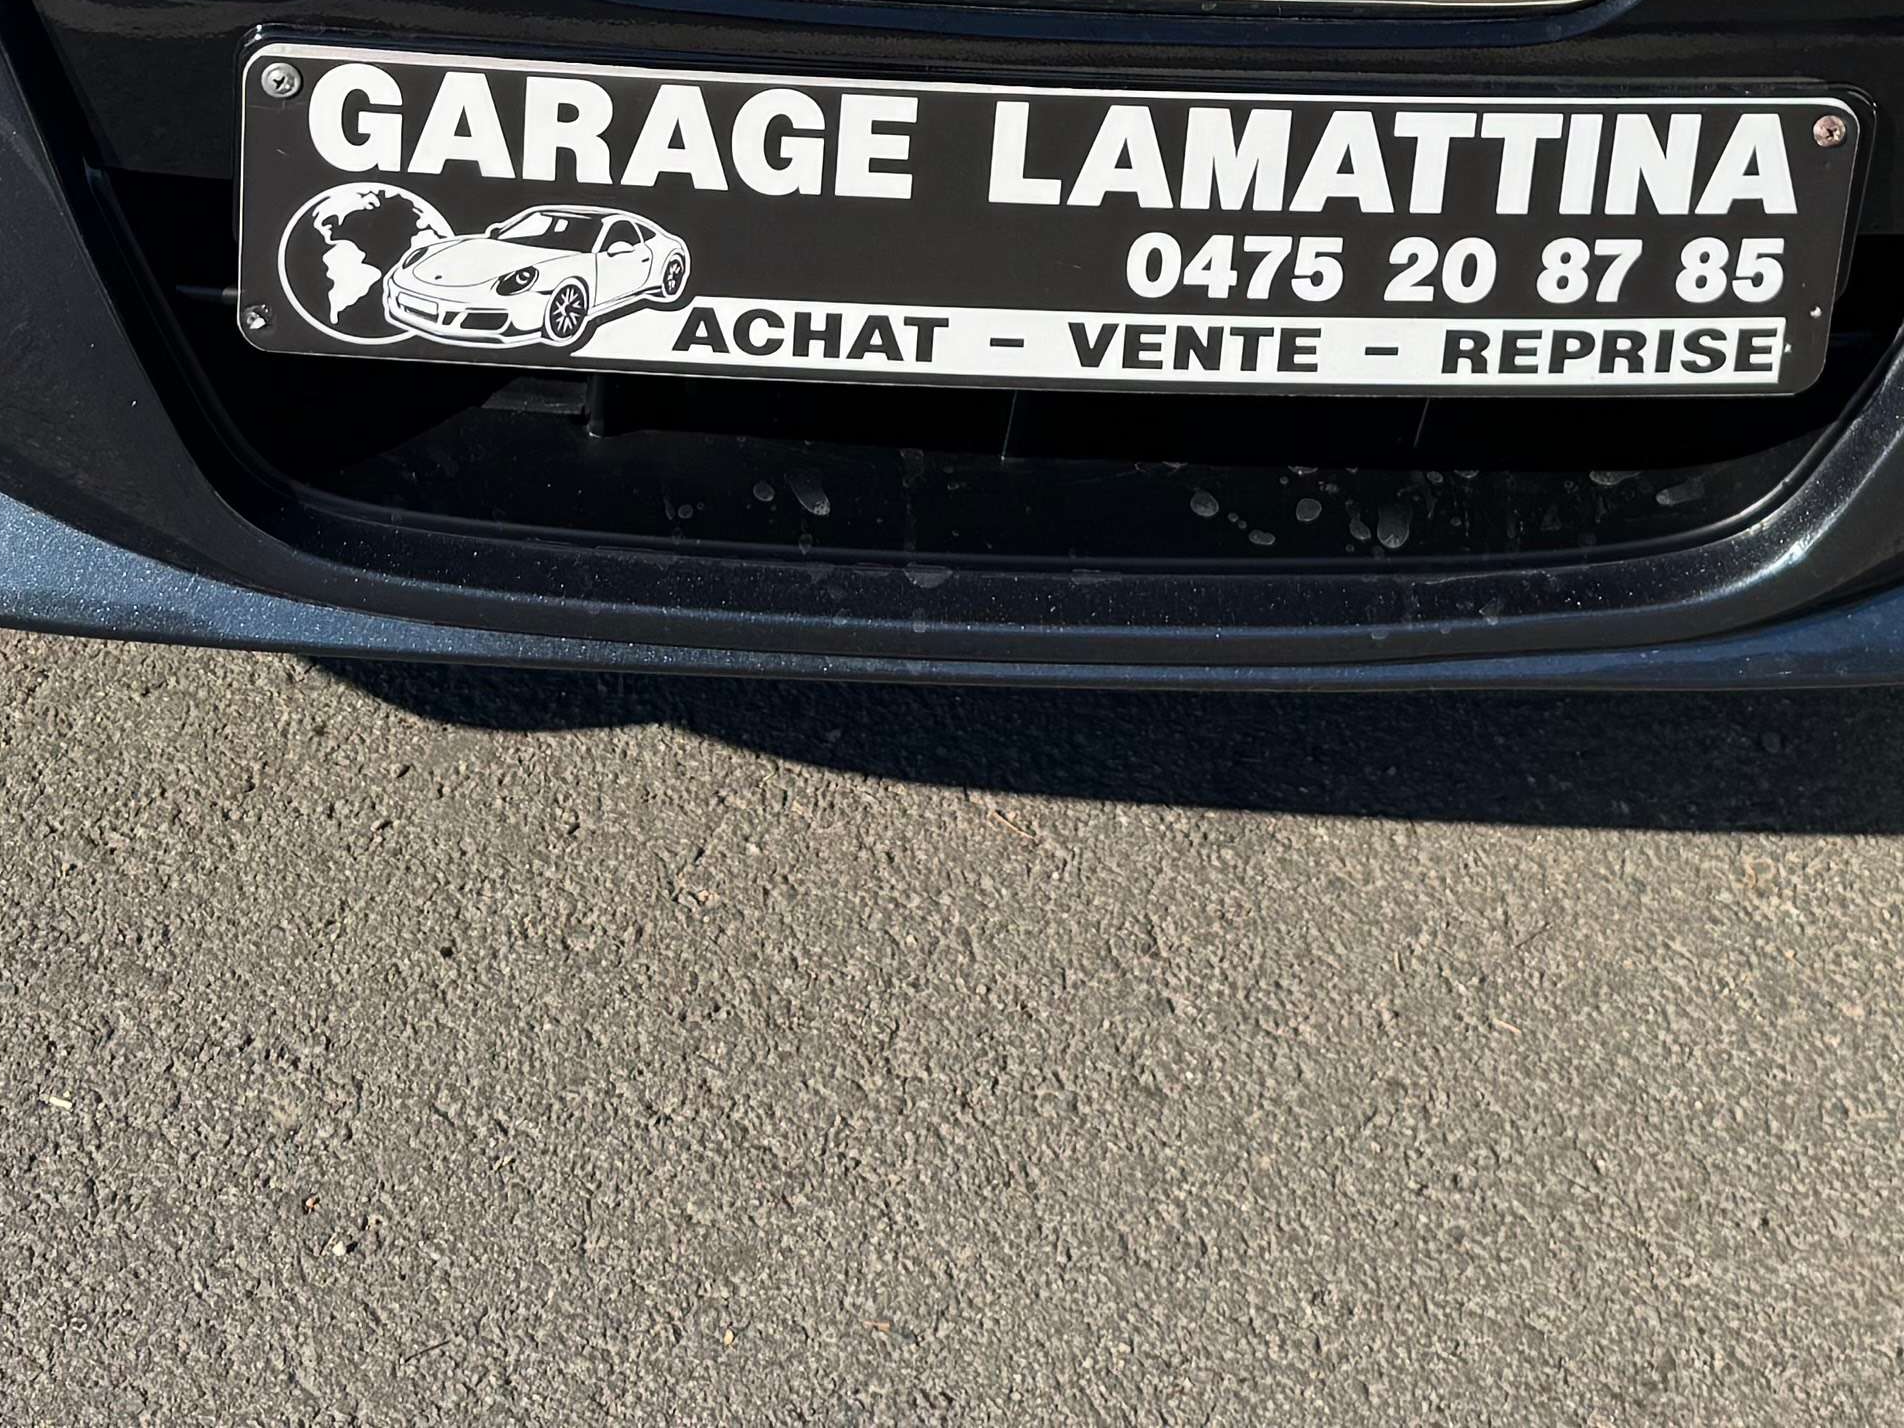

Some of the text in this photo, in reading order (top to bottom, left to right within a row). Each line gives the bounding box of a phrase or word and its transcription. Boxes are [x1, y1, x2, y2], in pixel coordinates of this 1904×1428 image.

[307, 63, 1797, 216] GARAGE LAMATTINA
[1124, 231, 1786, 304] 0475 20 87 85
[671, 306, 950, 363] ACHAT
[1068, 321, 1323, 374] VENTE
[1440, 327, 1777, 376] REPRISE
